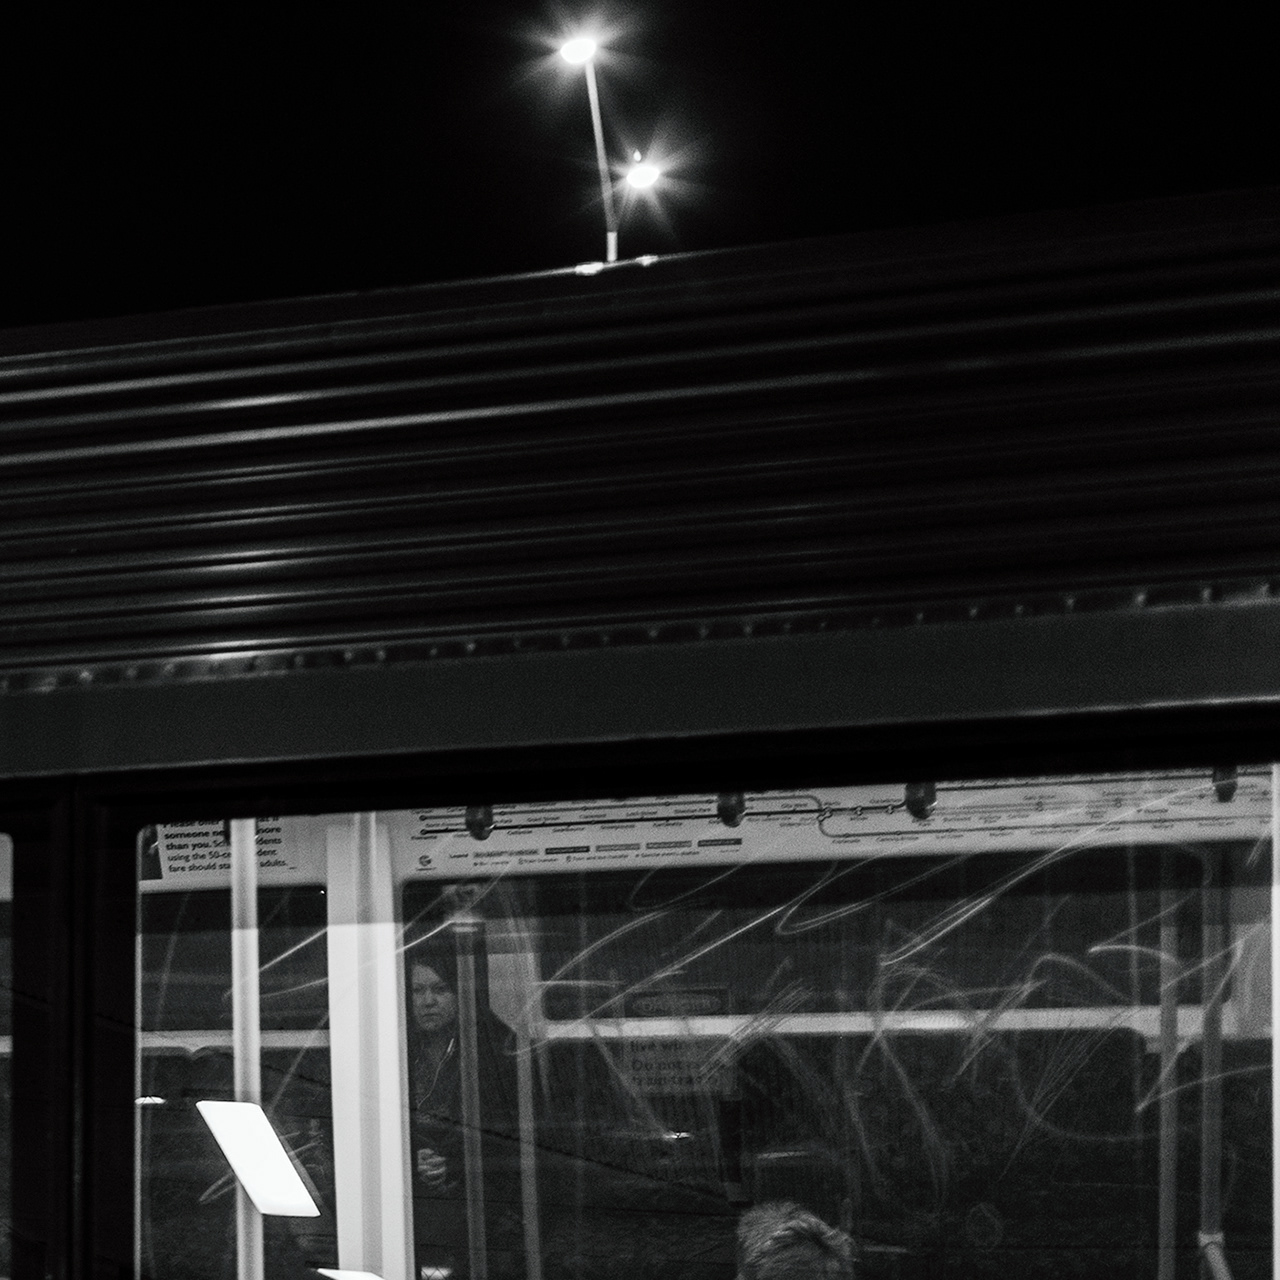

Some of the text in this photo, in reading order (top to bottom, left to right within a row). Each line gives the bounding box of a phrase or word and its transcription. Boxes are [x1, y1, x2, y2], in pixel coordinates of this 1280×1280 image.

[164, 831, 210, 839] someone
[166, 842, 189, 850] than
[209, 851, 231, 859] 50-ce
